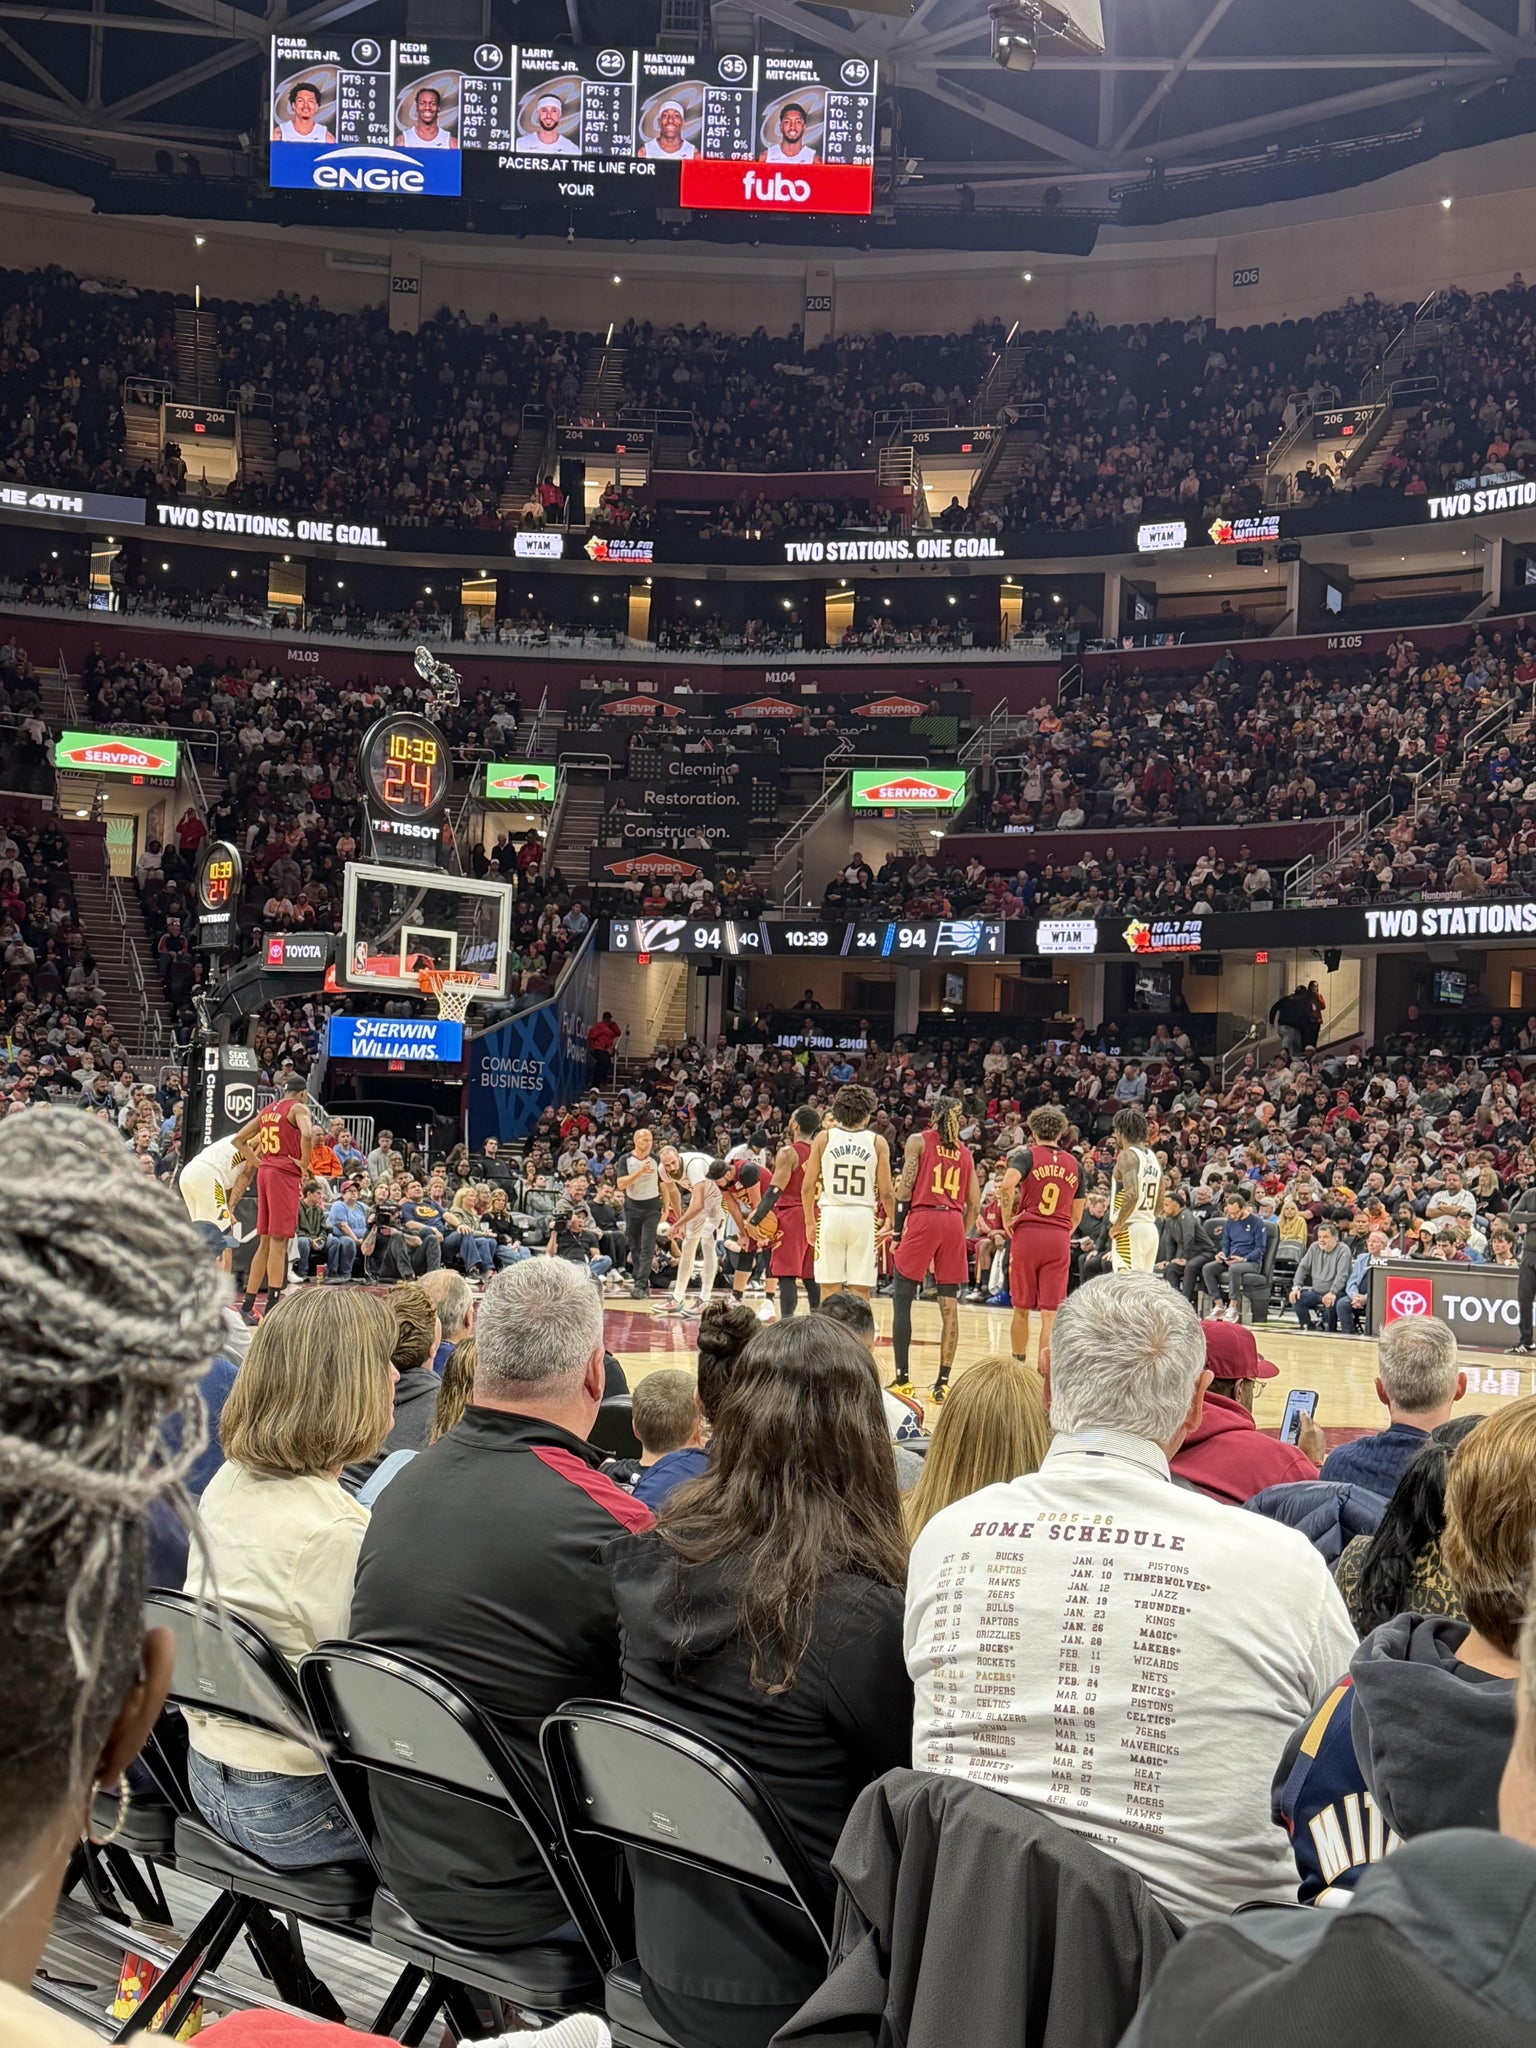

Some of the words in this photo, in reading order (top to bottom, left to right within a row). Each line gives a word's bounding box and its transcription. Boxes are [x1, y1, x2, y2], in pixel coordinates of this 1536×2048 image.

[277, 38, 307, 48] CRAIG
[400, 43, 427, 53] KEON
[277, 49, 322, 60] PORTER
[322, 51, 340, 61] JR.
[361, 44, 372, 56] 9
[481, 50, 499, 62] 14
[522, 48, 553, 58] LARRY
[400, 54, 430, 65] ELLIS
[522, 60, 560, 71] NANCE
[561, 61, 579, 72] JR.
[600, 55, 621, 67] 22
[766, 58, 813, 69] DONOVAN
[644, 65, 685, 76] TOMLIN
[723, 60, 743, 73] 35
[845, 65, 865, 78] 45
[766, 70, 820, 81] MITCHELL
[464, 80, 487, 91] PTS:
[492, 81, 502, 91] 11
[830, 96, 853, 107] PTS:
[572, 160, 596, 173] THE
[599, 161, 626, 174] LINE
[630, 162, 656, 175] FOR
[558, 183, 594, 196] YOUR
[743, 171, 811, 202] fubo
[1234, 270, 1259, 285] 206
[393, 279, 417, 292] 204
[807, 297, 832, 311] 205
[175, 409, 195, 420] 203
[206, 412, 225, 423] 204
[1323, 413, 1343, 425] 206
[1355, 409, 1375, 421] 207
[565, 430, 584, 440] 204
[626, 432, 645, 443] 205
[911, 433, 930, 443] 205
[972, 431, 992, 440] 206
[29, 493, 83, 512] 4TH
[1427, 493, 1471, 519] TWO
[156, 504, 200, 528] TWO
[202, 509, 295, 538] STATIONS.
[297, 520, 333, 542] ONE
[336, 524, 387, 547] GOAL.
[1233, 517, 1260, 528] 100.7
[1149, 531, 1174, 542] WTAM
[526, 541, 551, 550] WTAM
[609, 539, 635, 549] 100.7
[784, 543, 824, 561] TWO
[826, 540, 914, 561] STATIONS.
[917, 538, 951, 558] ONE
[954, 538, 1004, 557] GOAL.
[287, 649, 320, 663] M103
[765, 671, 796, 683] M104
[870, 704, 920, 715] SERVPRO
[389, 734, 437, 765] 10:39
[84, 750, 148, 766] SERVPRO
[150, 777, 175, 788] M103
[384, 759, 432, 809] 24
[644, 790, 740, 805] Restoration.
[879, 786, 938, 798] SERVPRO
[391, 821, 440, 840] TISSOT
[209, 862, 232, 879] 10:39
[209, 880, 229, 901] 24
[985, 925, 1000, 934] FLS
[1152, 921, 1178, 933] 100.7
[1365, 909, 1418, 938] TWO
[616, 934, 628, 948] 0
[694, 928, 721, 949] 94
[739, 932, 759, 947] 4Q
[785, 932, 828, 947] 10:39
[857, 932, 876, 947] 24
[899, 928, 926, 949] 94
[988, 937, 997, 952] 1
[1051, 931, 1082, 943] WTAM
[285, 944, 321, 958] TOYOTA
[353, 1018, 437, 1040] SHERWIN
[228, 1050, 248, 1059] SEAT
[352, 1039, 439, 1059] WILLIAMS.
[229, 1059, 250, 1068] GEEK
[481, 1056, 546, 1074] COMCAST
[481, 1072, 544, 1091] BUSINESS
[203, 1073, 216, 1145] Cleveland
[227, 1095, 252, 1117] ups
[260, 1126, 281, 1154] 35
[830, 1143, 871, 1162] THOMPSON
[936, 1145, 962, 1161] ELLIS
[1032, 1164, 1065, 1181] PORTER
[833, 1164, 866, 1197] 55
[931, 1162, 961, 1200] 14
[1037, 1182, 1060, 1216] 9
[1138, 1182, 1157, 1211] 29
[1036, 1512, 1114, 1526] 2025-26
[970, 1521, 1035, 1539] HOME
[1049, 1524, 1186, 1552] SCHEDULE
[995, 1551, 1024, 1561] BUCKS
[987, 1564, 1027, 1575] RAPTORS
[1072, 1556, 1095, 1566] JAN.
[1102, 1557, 1114, 1567] 04
[1148, 1561, 1190, 1575] PISTONS
[1070, 1569, 1094, 1579] JAN.
[1101, 1571, 1112, 1580] 10
[988, 1577, 1020, 1587] HAWKS
[987, 1590, 1015, 1599] 76ERS
[1151, 1588, 1179, 1600] JAZZ
[986, 1603, 1014, 1612] BULLS
[980, 1616, 1019, 1627] RAPTORS
[1145, 1614, 1176, 1627] KINGS
[976, 1630, 1021, 1640] GRIZZLIES
[977, 1656, 1016, 1668] ROCKETS
[1133, 1655, 1180, 1671] WIZARDS
[1142, 1670, 1168, 1683] NETS
[974, 1684, 1016, 1695] CLIPPERS
[1131, 1697, 1174, 1712] PISTONS
[973, 1732, 1016, 1746] WARRIORS
[1135, 1726, 1167, 1739] 76ERS
[1121, 1738, 1180, 1756] MAVERICKS
[967, 1770, 1009, 1785] PELICANS
[1134, 1768, 1162, 1781] HEAT
[1133, 1781, 1161, 1794] HEAT
[1127, 1794, 1164, 1808] PACERS
[1125, 1807, 1162, 1820] HAWKS
